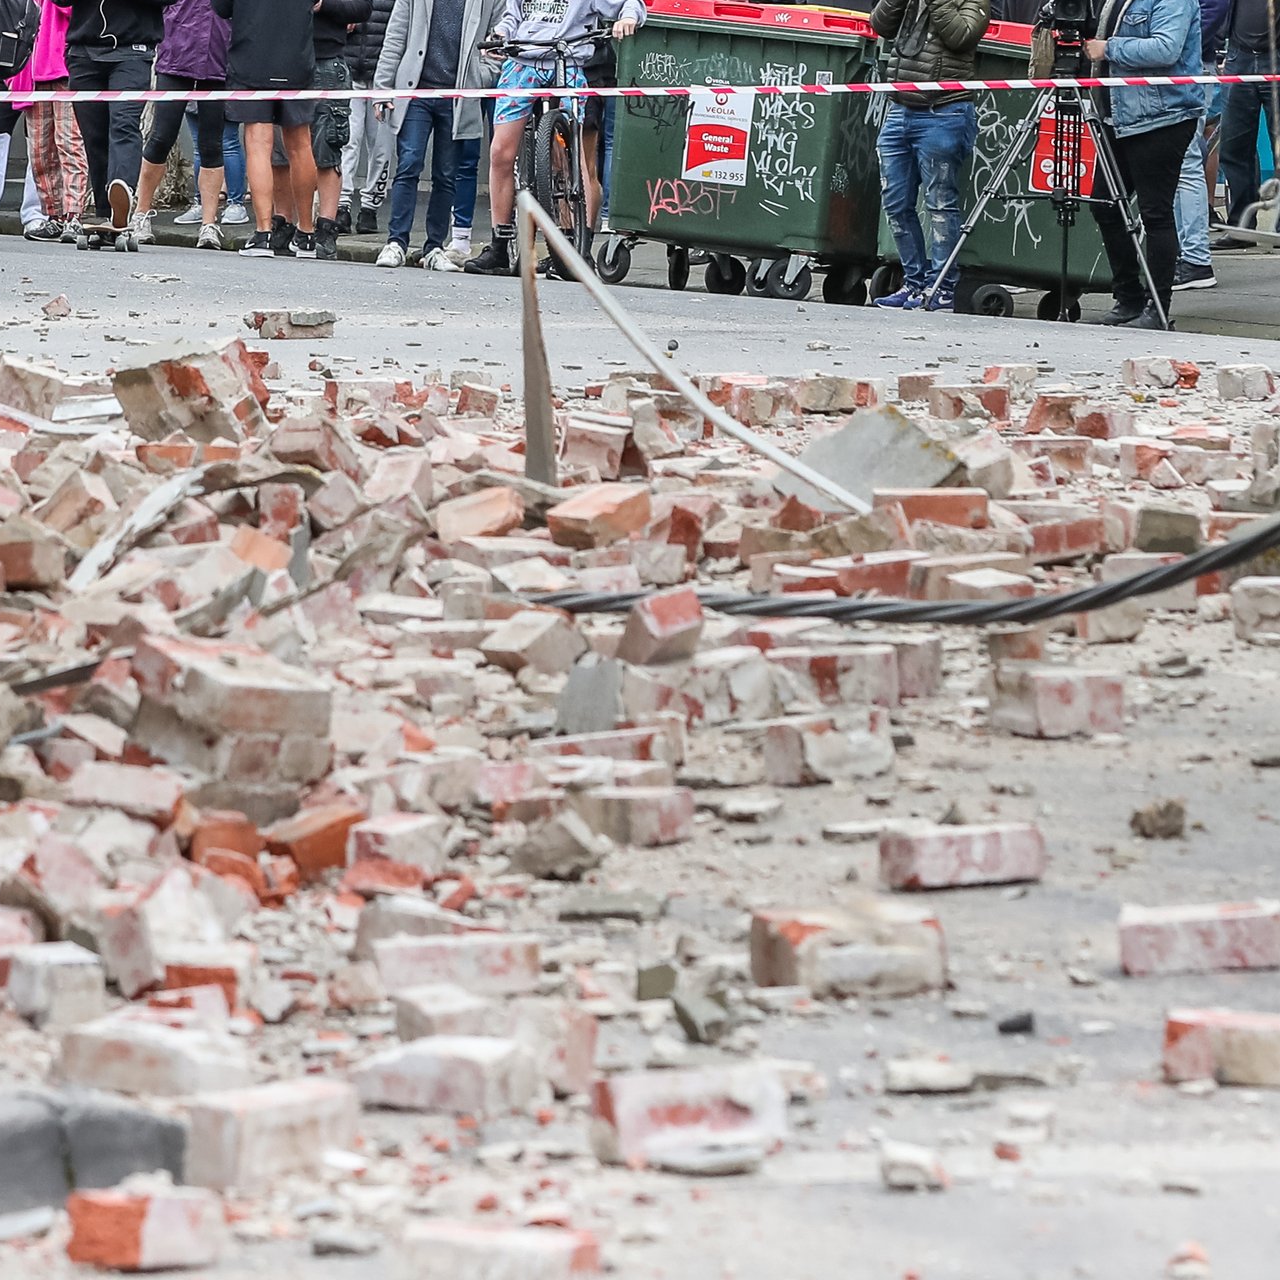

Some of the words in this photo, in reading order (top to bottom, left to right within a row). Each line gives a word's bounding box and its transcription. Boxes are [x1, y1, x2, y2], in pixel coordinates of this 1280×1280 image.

[705, 106, 735, 116] VEOLIA
[702, 132, 733, 144] General
[704, 143, 729, 154] Waste
[714, 170, 728, 180] 132
[729, 172, 744, 182] 955
